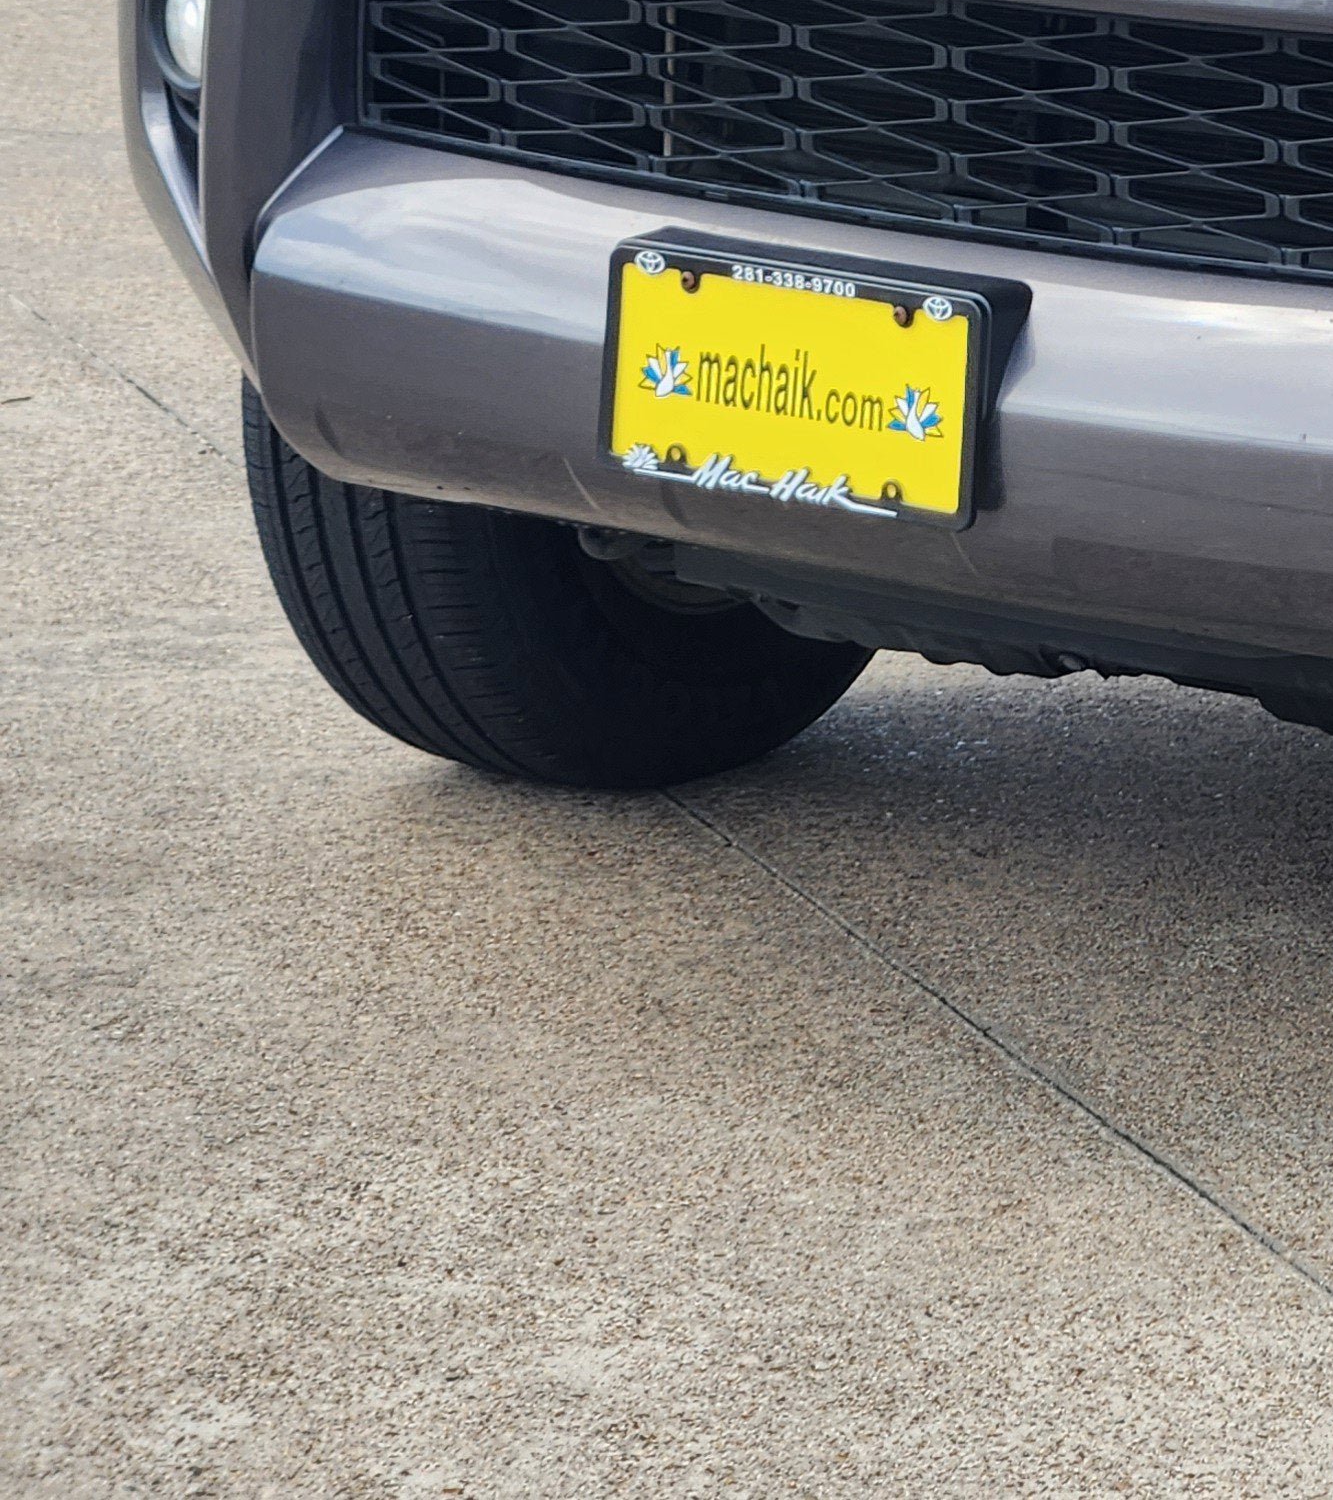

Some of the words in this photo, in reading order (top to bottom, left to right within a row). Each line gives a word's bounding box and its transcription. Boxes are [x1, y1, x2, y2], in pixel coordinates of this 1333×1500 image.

[731, 264, 857, 299] 281-338-9700
[695, 343, 885, 432] machaik.com
[692, 454, 769, 493] Mac
[769, 468, 866, 506] Haik
